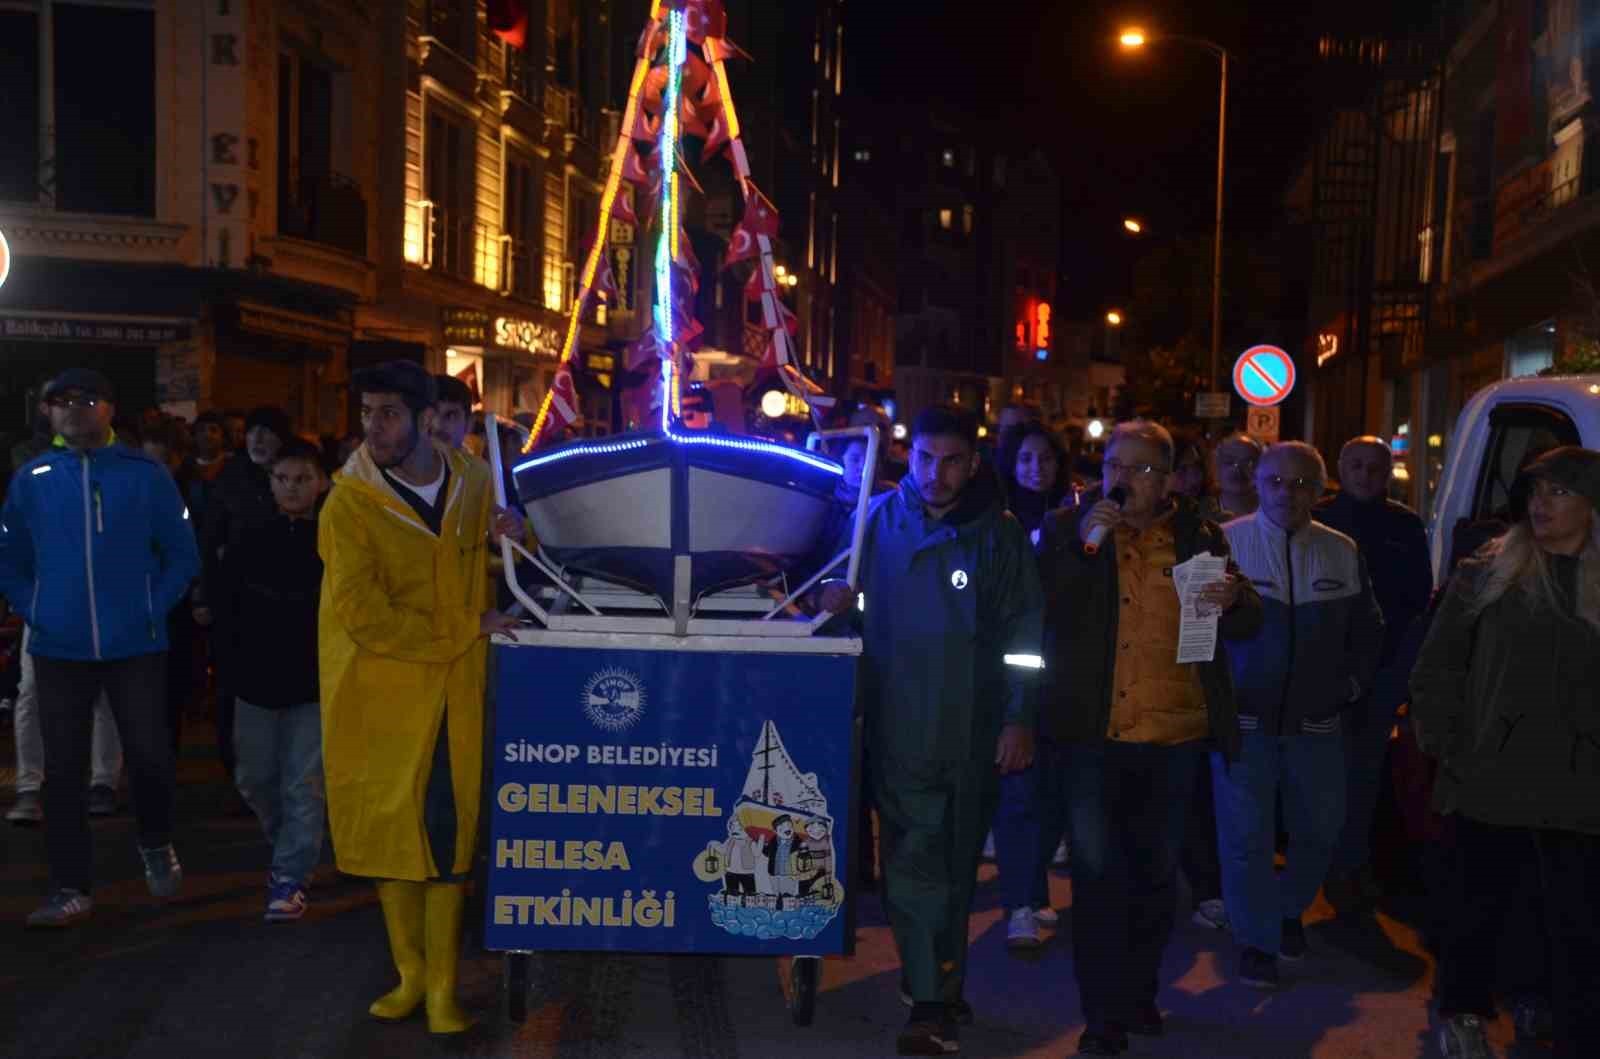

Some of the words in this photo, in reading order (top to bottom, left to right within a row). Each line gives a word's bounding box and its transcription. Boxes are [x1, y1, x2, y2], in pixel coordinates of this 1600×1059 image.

[504, 739, 580, 764] SİNOP
[587, 741, 718, 767] BELEDİYESİ
[497, 782, 722, 817] GELENEKSEL
[495, 839, 631, 871] HELESA
[494, 888, 676, 928] ETKİNLİĞİ
